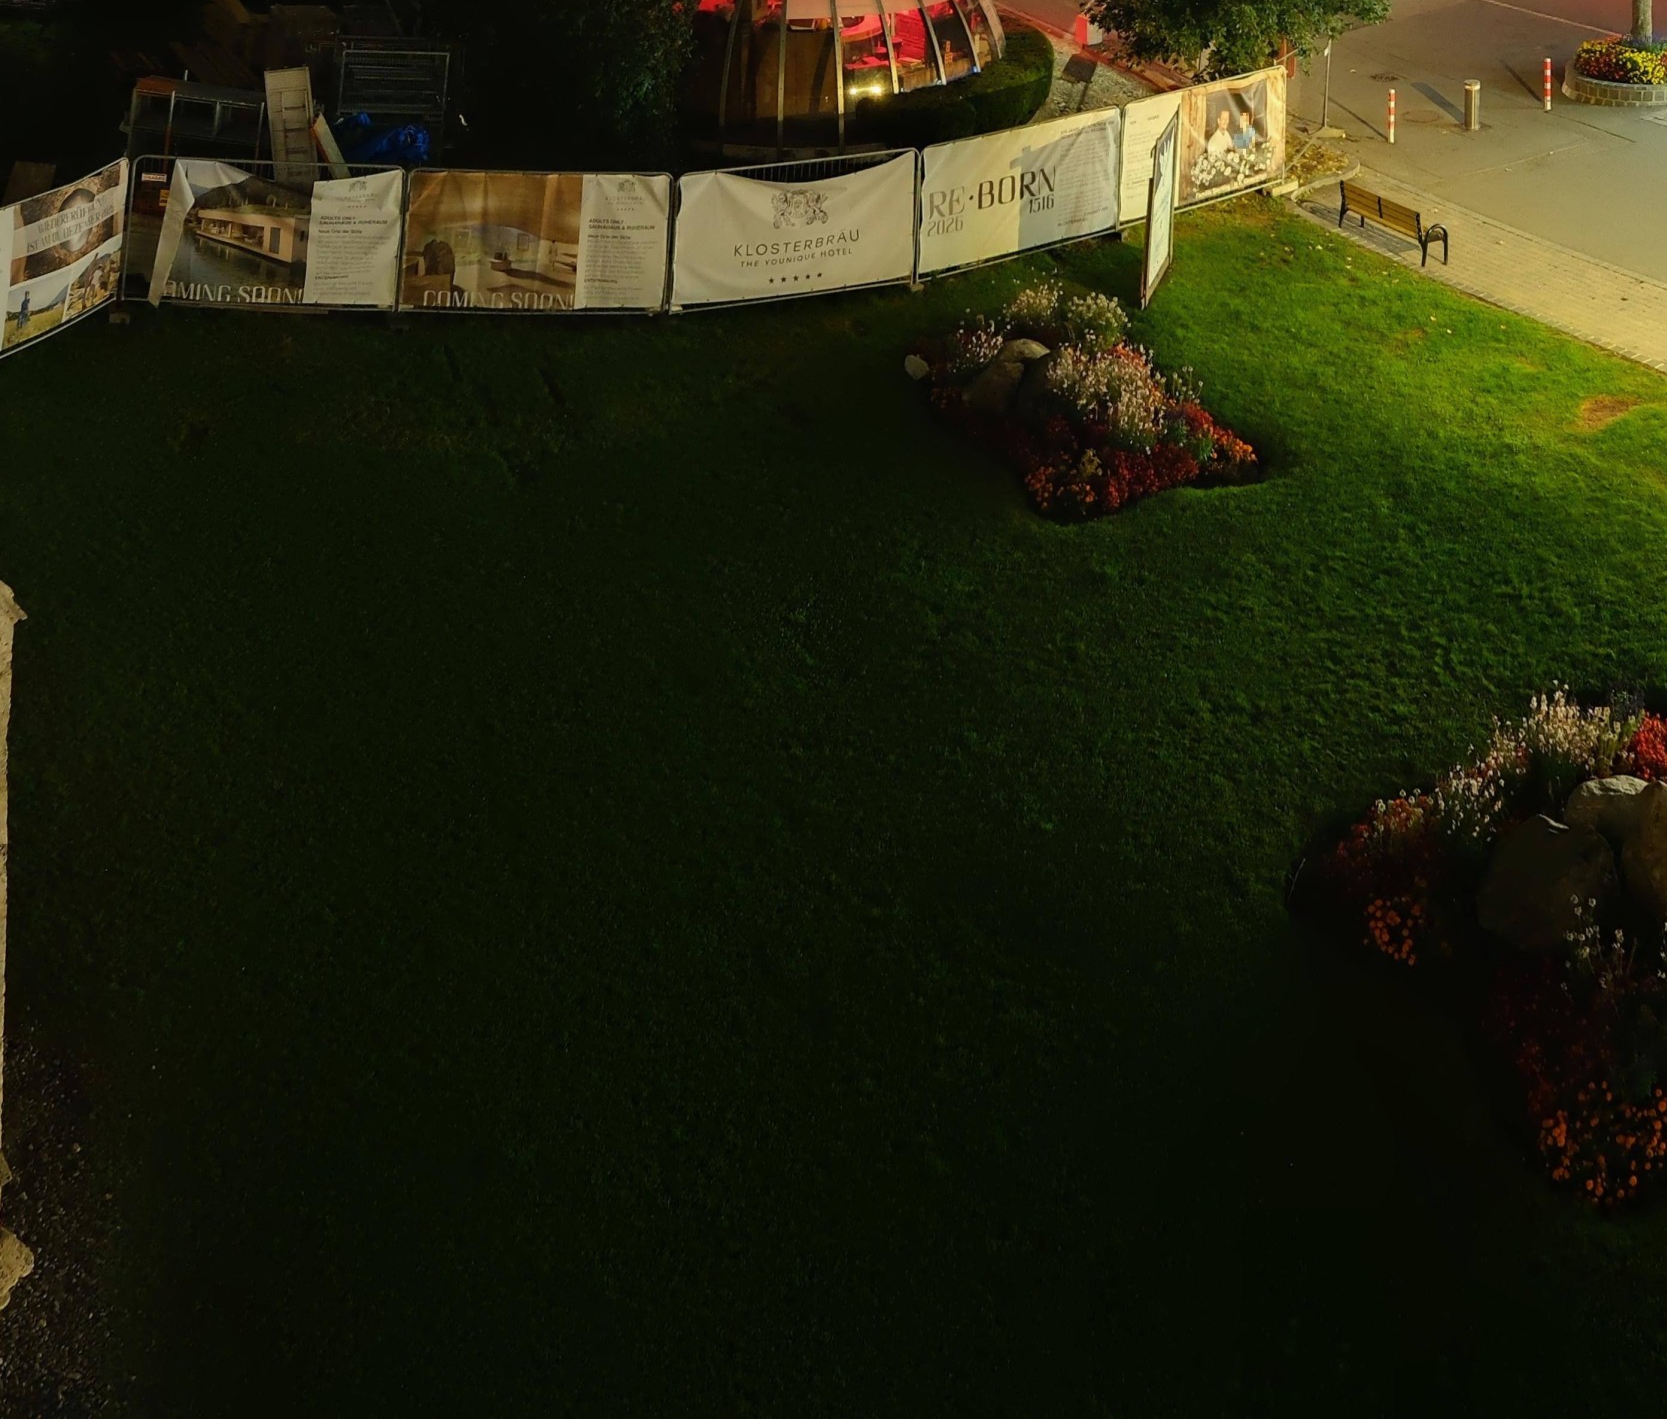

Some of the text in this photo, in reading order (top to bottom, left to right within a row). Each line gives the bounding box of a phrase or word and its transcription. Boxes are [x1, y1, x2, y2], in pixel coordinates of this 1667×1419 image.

[1028, 192, 1055, 214] 1516
[927, 216, 964, 237] 2026
[734, 229, 860, 257] KLOSTERBRÄU
[740, 247, 853, 268] THE YOUNIQUE HOTEL
[163, 280, 231, 302] OMING
[423, 290, 504, 309] COMING
